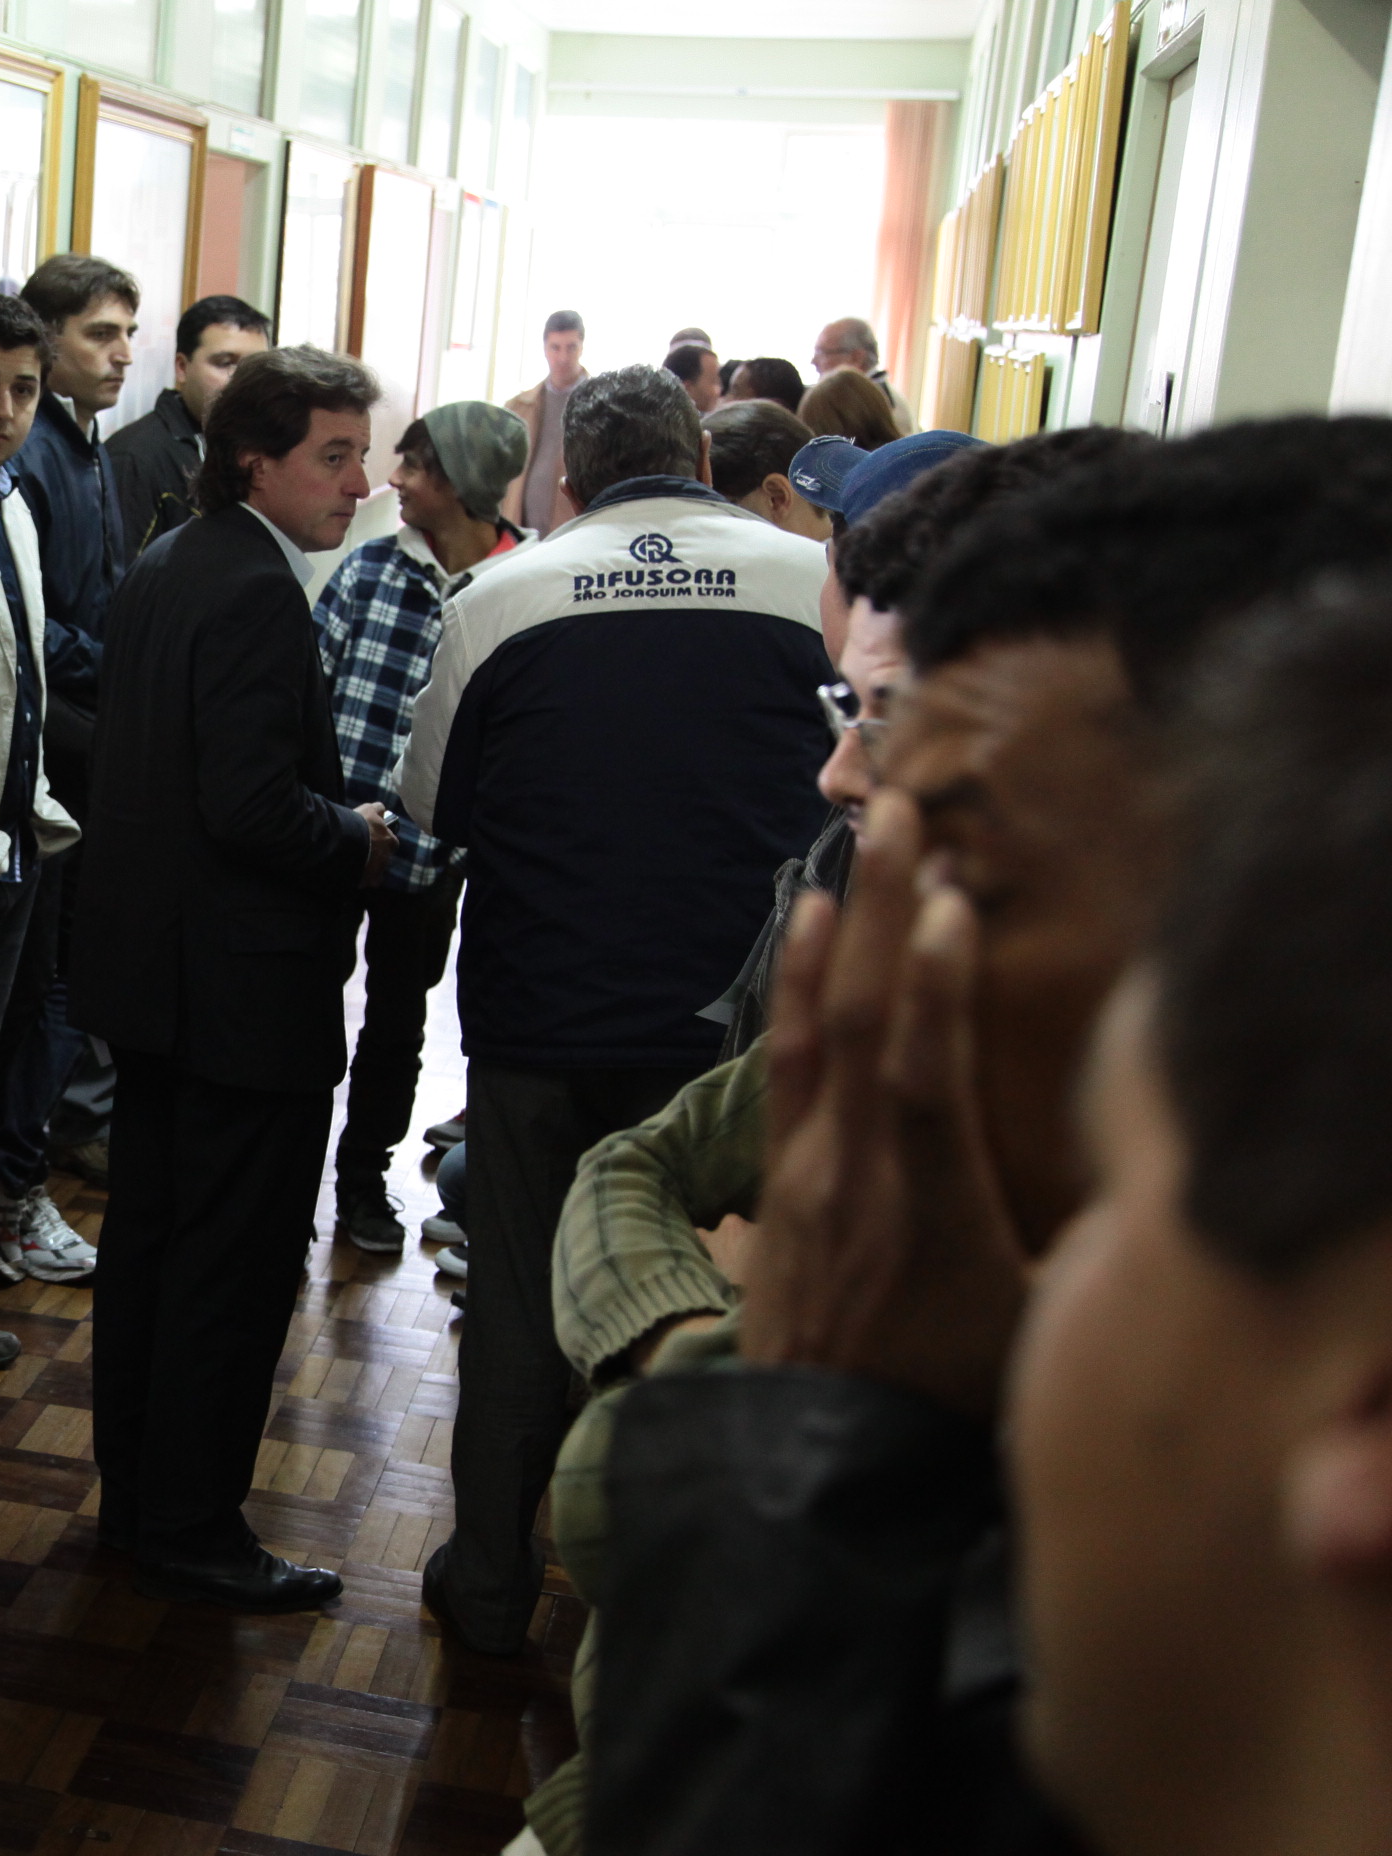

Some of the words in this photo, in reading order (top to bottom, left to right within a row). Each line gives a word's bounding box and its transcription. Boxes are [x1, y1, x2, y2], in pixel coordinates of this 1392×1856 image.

[574, 568, 736, 591] DIFUSORA
[573, 589, 607, 602] SÃO
[612, 587, 692, 598] JOAQUIM
[697, 587, 736, 598] LTDA
